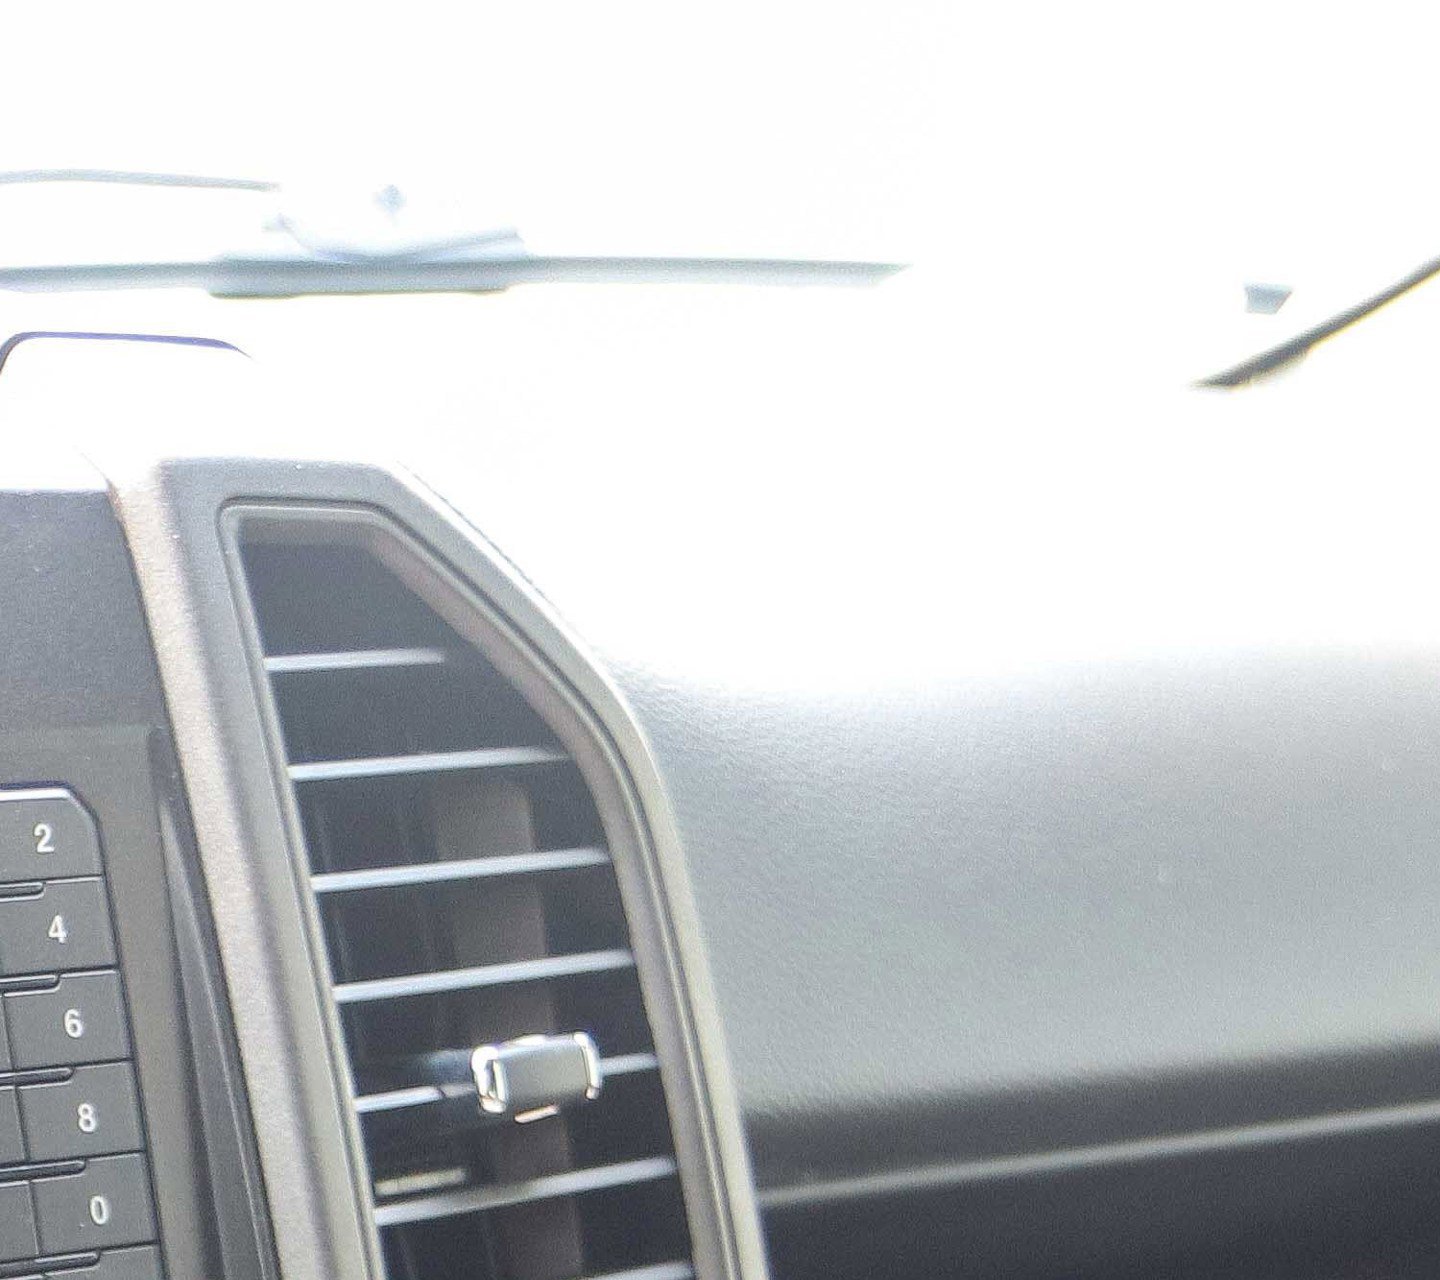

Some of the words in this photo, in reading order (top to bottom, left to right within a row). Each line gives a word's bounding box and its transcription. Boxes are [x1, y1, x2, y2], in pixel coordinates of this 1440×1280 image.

[35, 824, 56, 854] 2
[49, 915, 68, 944] 4
[65, 1009, 85, 1039] 6
[78, 1103, 99, 1133] 8
[91, 1196, 111, 1226] 0
